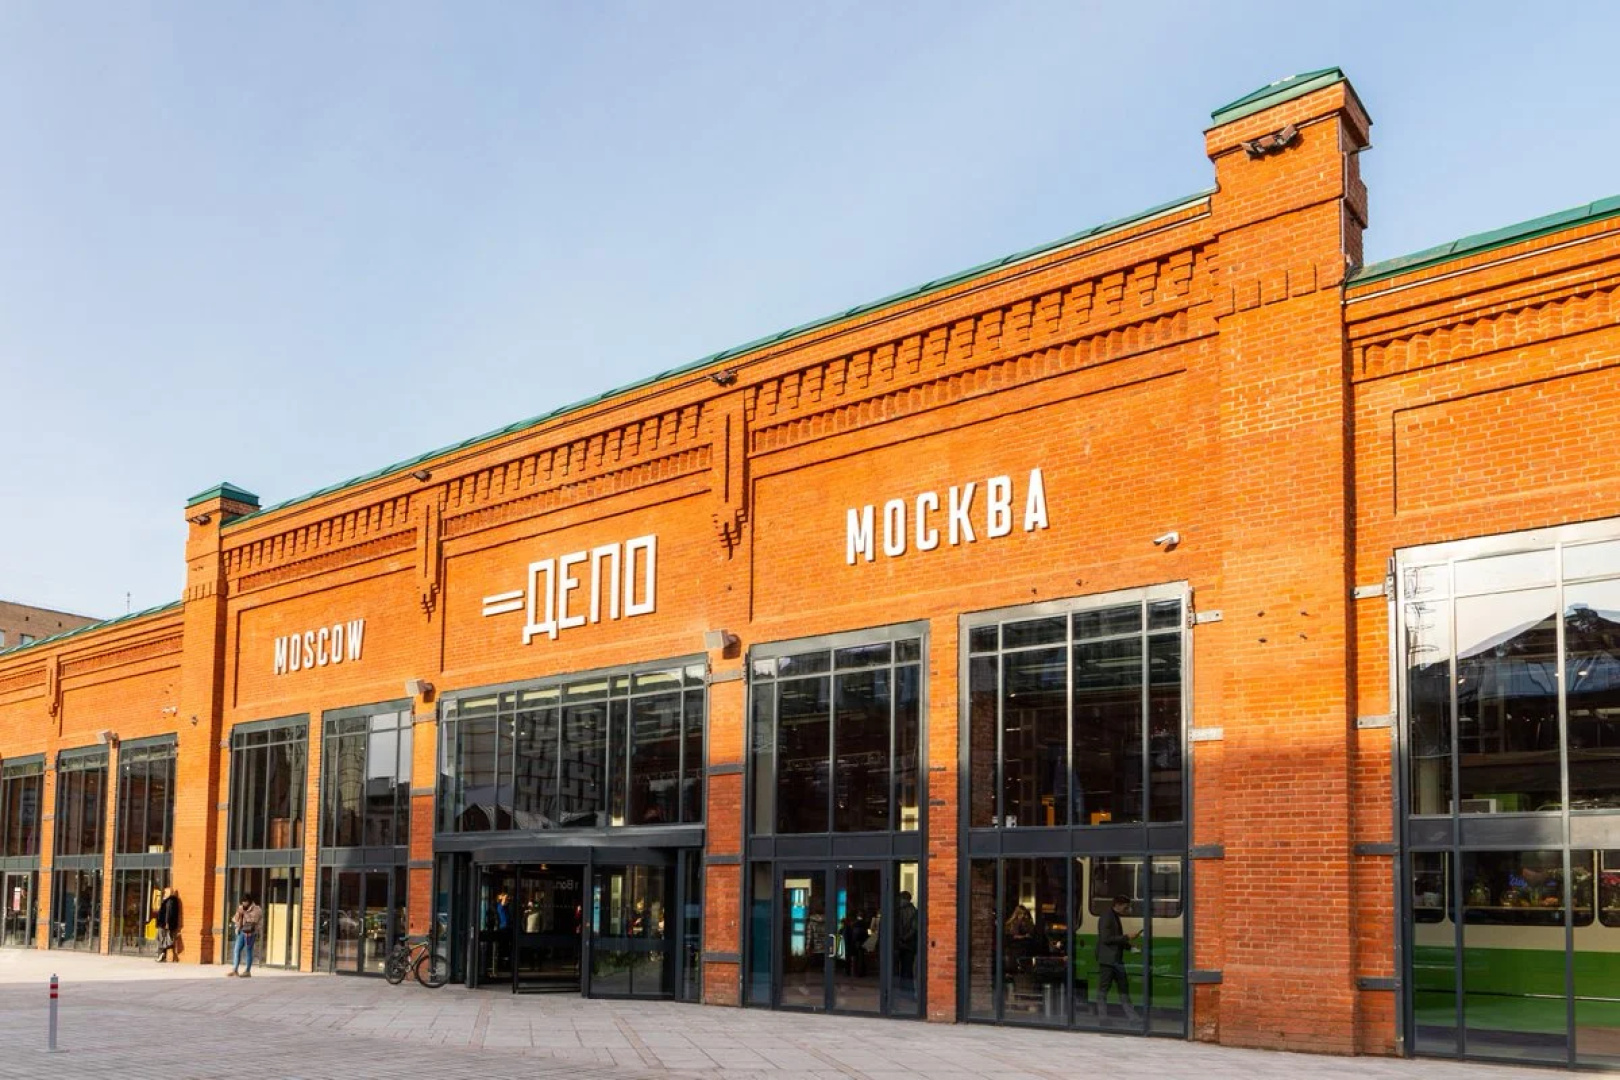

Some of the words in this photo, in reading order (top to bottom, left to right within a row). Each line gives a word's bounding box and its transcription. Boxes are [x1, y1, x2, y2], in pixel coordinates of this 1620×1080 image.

[846, 467, 1048, 565] МОСКВА
[522, 533, 657, 645] ДЕПО
[273, 619, 364, 674] MOSCOW
